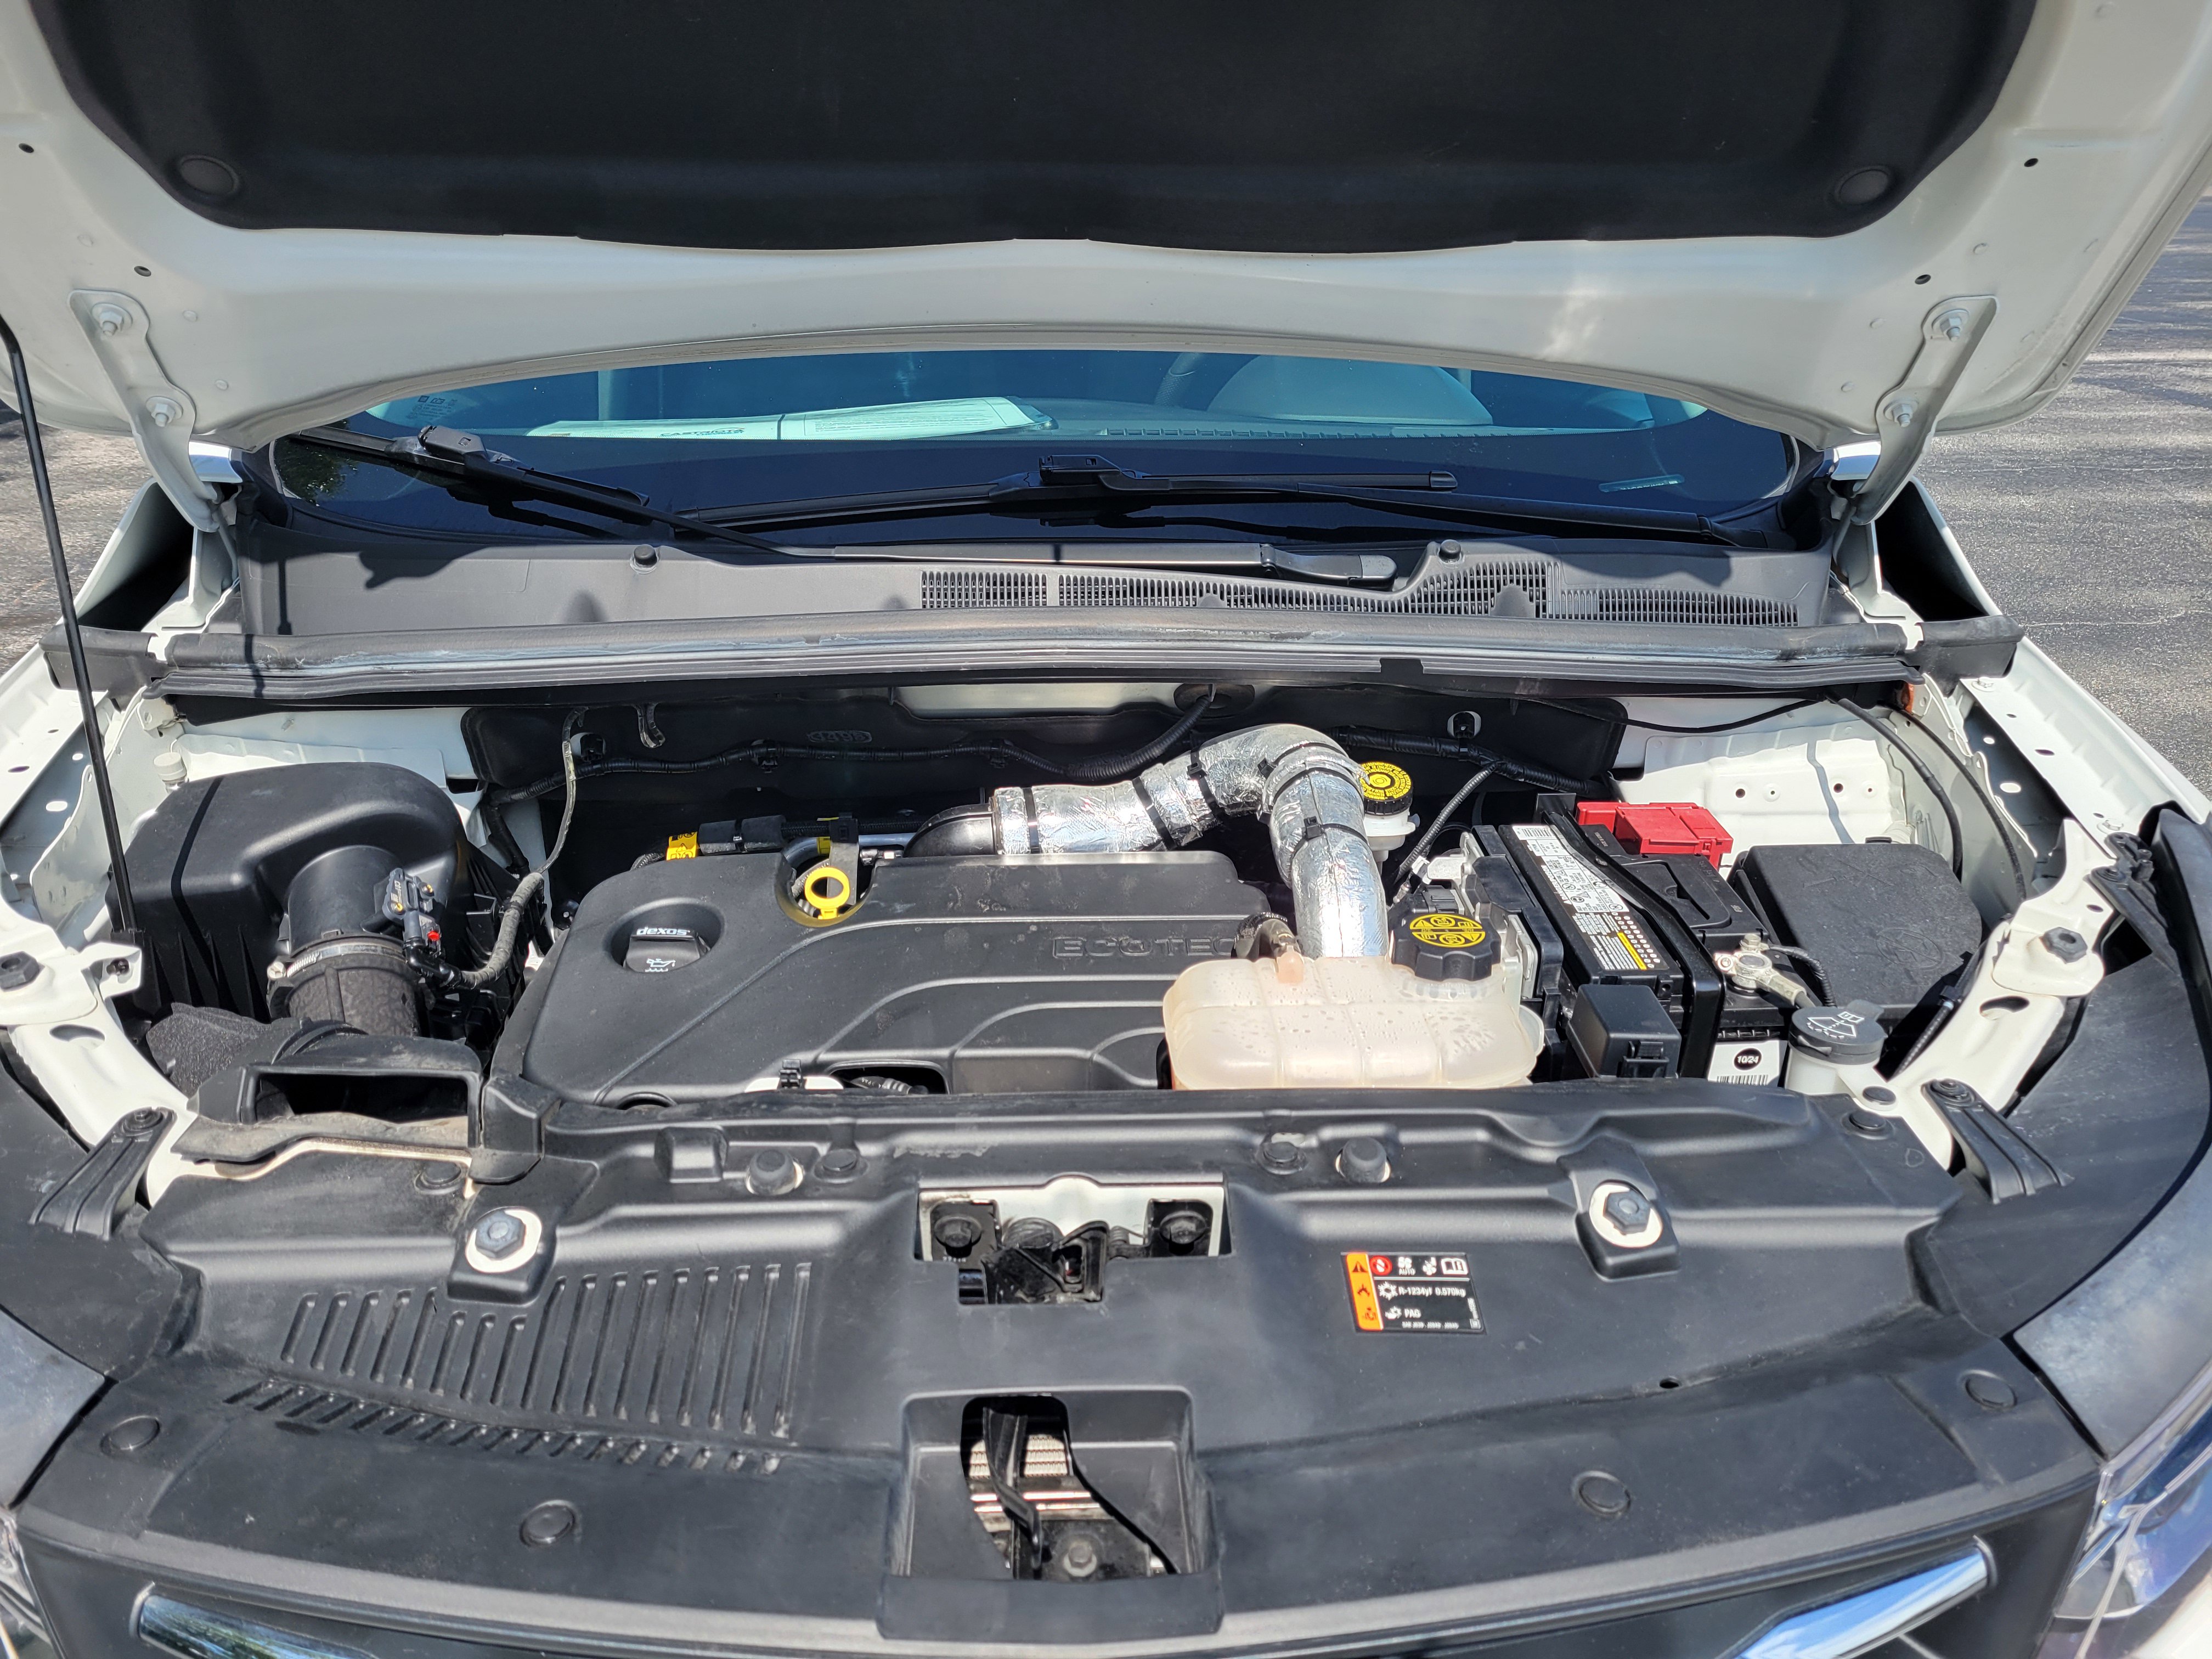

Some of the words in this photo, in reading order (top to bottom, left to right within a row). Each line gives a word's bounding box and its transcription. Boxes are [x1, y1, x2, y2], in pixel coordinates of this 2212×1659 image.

[636, 926, 687, 935] dexos
[1052, 936, 1236, 958] ECOTEC
[1737, 1056, 1759, 1064] 10/24
[1398, 1286, 1433, 1297] R-1234yf
[1435, 1287, 1466, 1297] 0.570kg
[1404, 1308, 1421, 1318] PAG
